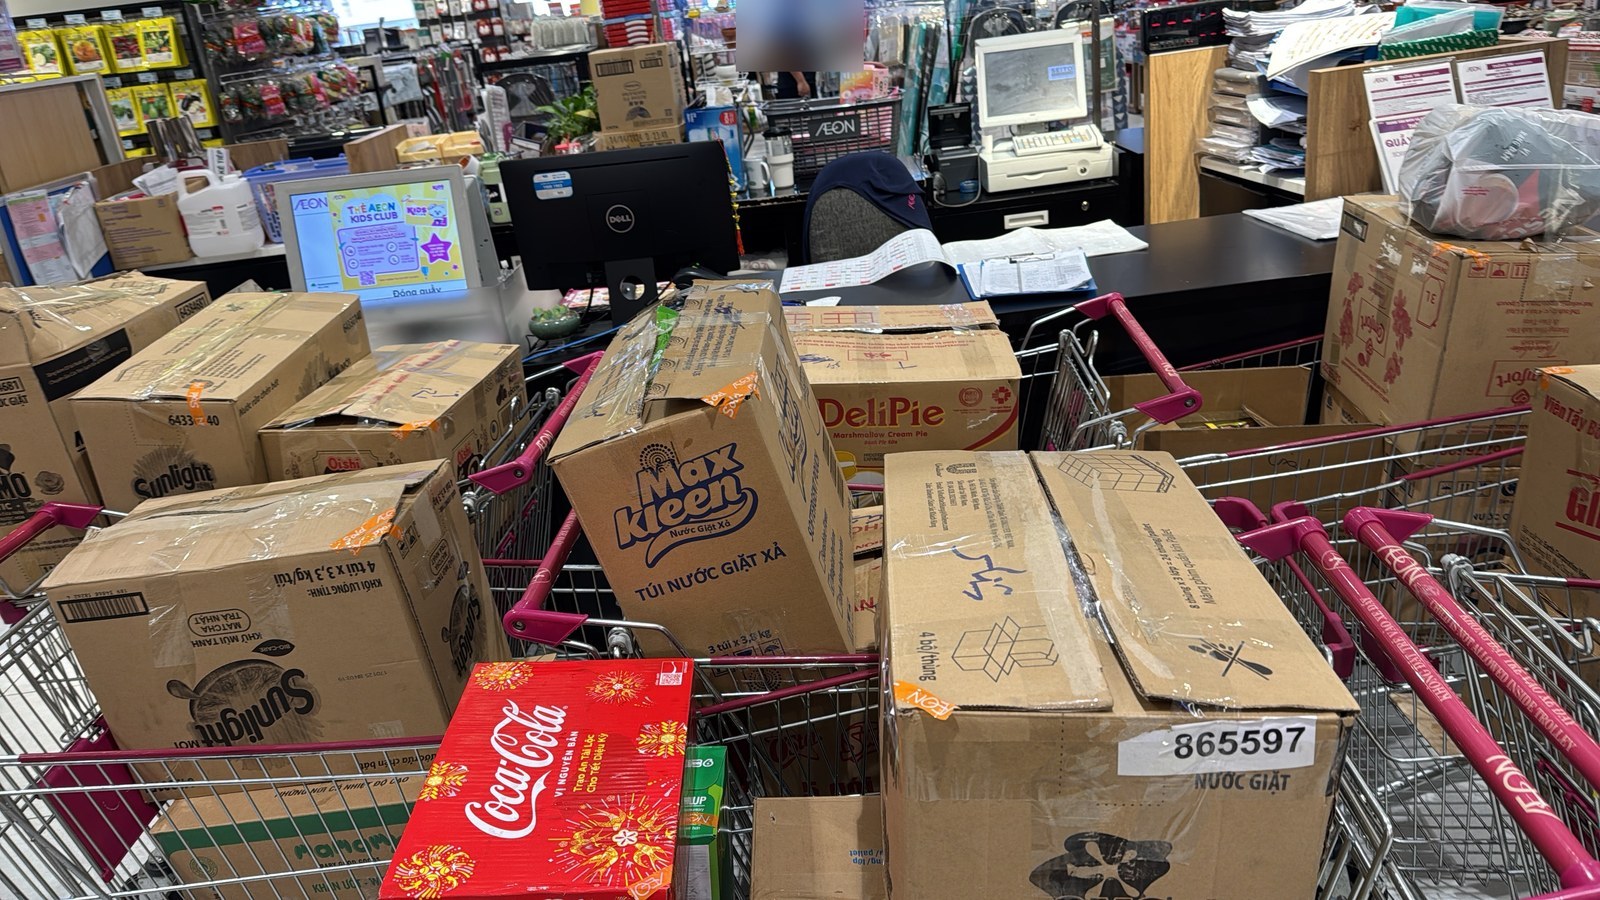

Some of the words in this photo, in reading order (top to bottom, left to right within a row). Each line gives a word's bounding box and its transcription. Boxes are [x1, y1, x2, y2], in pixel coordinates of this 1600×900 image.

[368, 202, 395, 212] AEON
[351, 213, 372, 223] KIDS
[374, 212, 398, 220] CLUB
[609, 214, 631, 223] DELL
[818, 396, 944, 428] DeliPie
[327, 455, 361, 470] Oishi
[133, 464, 214, 498] Sunlight
[636, 443, 744, 507] Max
[670, 524, 696, 538] Nước
[697, 522, 717, 535] Giặt
[717, 518, 731, 529] Xả
[313, 565, 335, 582] 3,3
[337, 565, 345, 576] x
[346, 562, 366, 578] túi
[367, 560, 376, 572] 4
[635, 580, 665, 603] TÚI
[667, 567, 719, 595] NƯỚC
[721, 554, 758, 576] GIẶT
[760, 542, 786, 562] XẢ
[273, 566, 313, 588] kg/túi
[306, 584, 329, 598] TỊNH:
[330, 579, 359, 595] LƯỢNG
[360, 578, 383, 595] KHỐI
[194, 614, 220, 626] NHẬT
[221, 612, 241, 625] TRÀ
[200, 621, 242, 634] MATCHA
[191, 638, 220, 649] TANH
[221, 634, 240, 646] MÙI
[240, 632, 262, 646] KHỬ
[717, 638, 731, 651] túi
[759, 629, 772, 641] kg
[194, 668, 314, 747] Sunlight
[1469, 644, 1509, 684] ALLOWED
[1503, 678, 1538, 713] INSIDE
[1530, 706, 1578, 755] TROLLEY
[567, 730, 579, 748] BẢN
[1173, 725, 1307, 760] 865597
[580, 760, 589, 774] An
[585, 733, 596, 749] Lộc
[464, 698, 566, 839] Coca-Cola
[558, 750, 574, 783] NGUYÊN
[589, 761, 600, 777] Tết
[554, 784, 566, 797] VỊ
[586, 777, 598, 794] Cho
[1249, 773, 1291, 795] GIẶT
